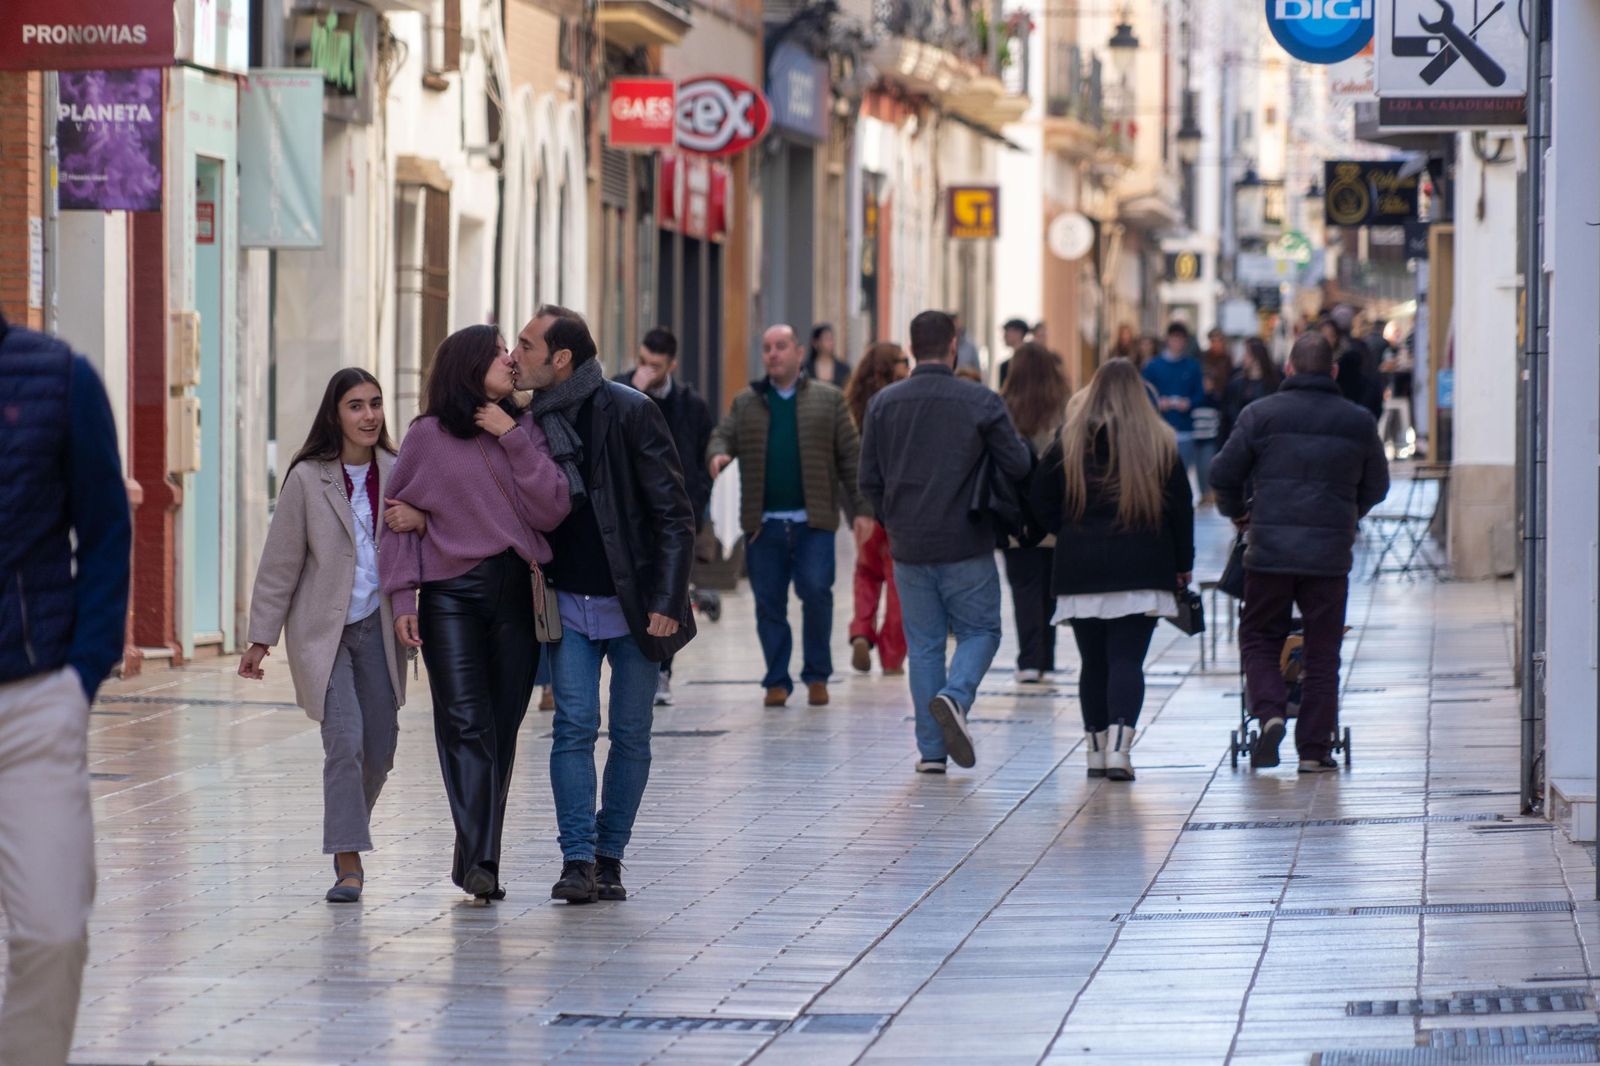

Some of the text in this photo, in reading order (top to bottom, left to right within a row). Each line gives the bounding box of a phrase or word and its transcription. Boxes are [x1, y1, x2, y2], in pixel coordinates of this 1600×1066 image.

[1275, 0, 1372, 19] DIGI
[22, 24, 147, 44] PRONOVIAS
[58, 104, 153, 121] PLANETA
[611, 96, 673, 121] GAES
[1389, 100, 1424, 112] LOLA
